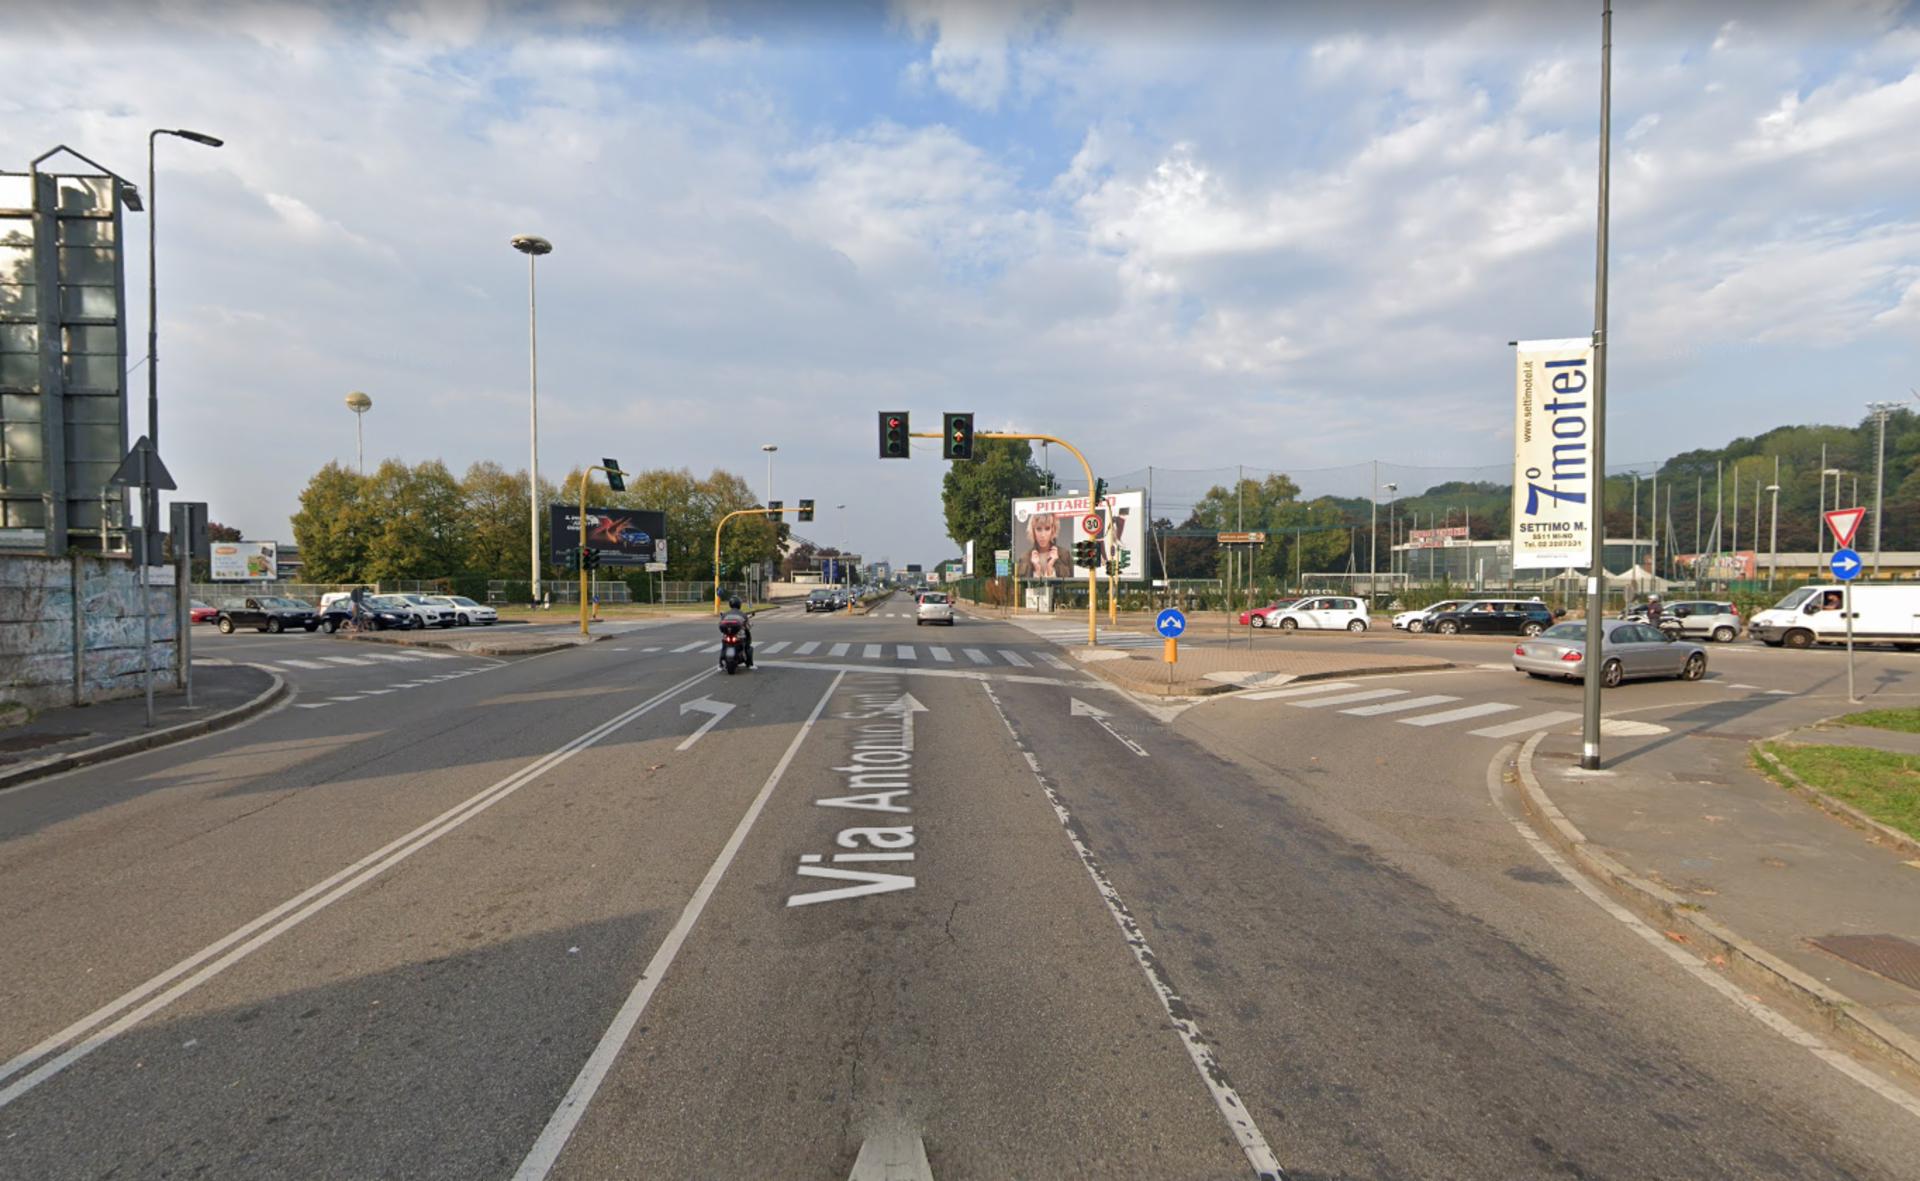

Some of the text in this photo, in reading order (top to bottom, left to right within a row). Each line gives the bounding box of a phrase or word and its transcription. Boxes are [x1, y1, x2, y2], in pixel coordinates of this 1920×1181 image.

[1523, 361, 1534, 443] www.settimotel.it
[1036, 495, 1117, 512] PITTAREO
[1086, 518, 1099, 530] 30
[1519, 521, 1588, 533] SETTIMO M.
